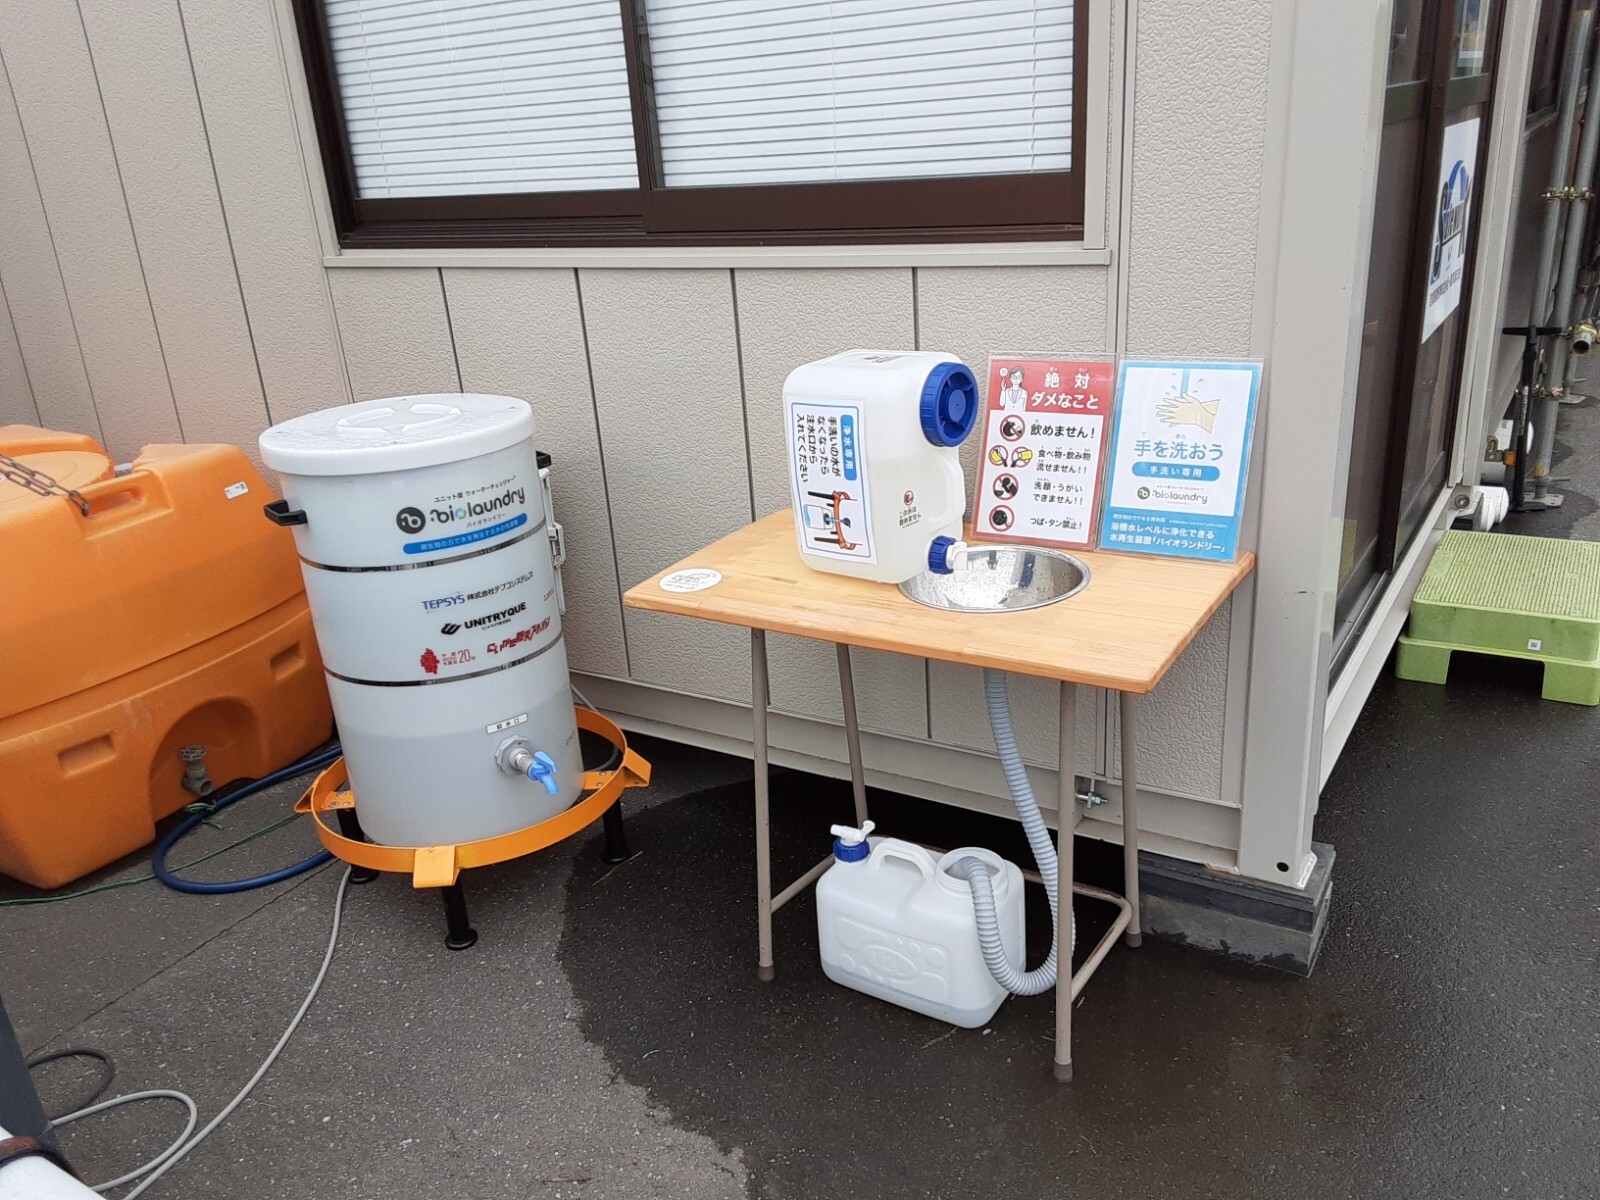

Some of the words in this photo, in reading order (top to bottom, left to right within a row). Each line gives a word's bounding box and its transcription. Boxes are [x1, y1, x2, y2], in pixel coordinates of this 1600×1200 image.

[1030, 391, 1099, 409] ダメなこと
[806, 414, 818, 464] 注水口から
[1030, 424, 1095, 439] 飲めません！
[796, 413, 808, 483] 入れてください
[817, 415, 829, 475] なくなったら
[827, 416, 841, 477] 手洗いの水が
[843, 425, 854, 469] 浄水専用
[1134, 439, 1223, 461] 手を洗おう
[1038, 449, 1091, 461] 食べ物・飲み物
[1036, 463, 1087, 474] 流せません！！
[1149, 465, 1203, 478] 手洗い専用
[1034, 481, 1083, 493] 洗顔・うがい
[1033, 493, 1083, 505] できません！！
[1030, 518, 1082, 530] つば・タン禁止！
[1111, 522, 1215, 539] 浴槽水レベルに浄化できる
[1109, 533, 1226, 553] 水再生装置「バイオランドリー」
[421, 595, 465, 610] TEPSYS
[464, 602, 527, 629] UNITRYQUE
